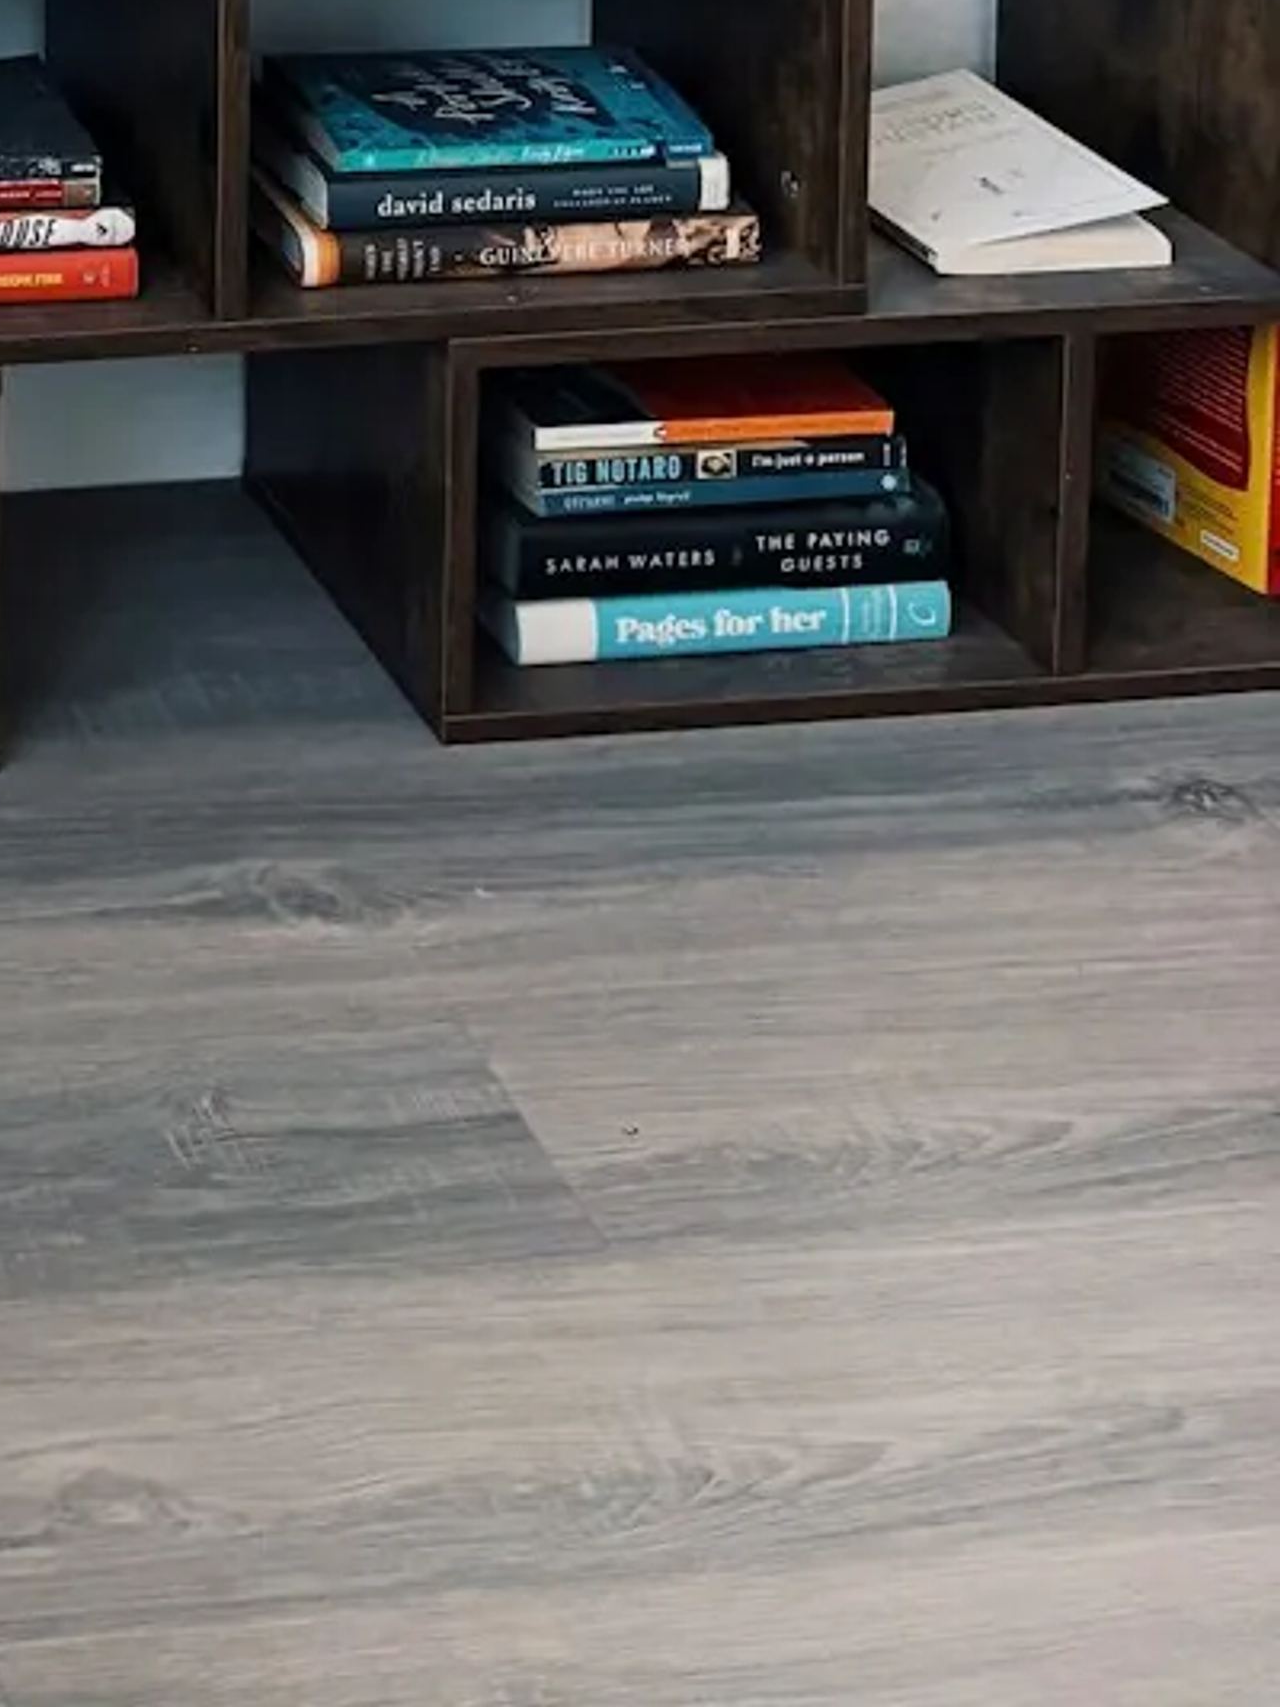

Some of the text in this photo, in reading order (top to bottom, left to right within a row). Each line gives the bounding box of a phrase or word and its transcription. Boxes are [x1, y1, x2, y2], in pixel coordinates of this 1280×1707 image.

[377, 187, 537, 218] david sedaris
[551, 454, 683, 486] TIG NOTARO
[817, 451, 865, 467] person
[755, 529, 891, 551] THE PAYING
[545, 549, 716, 576] SARAH WATERS
[780, 555, 864, 574] GUESTS
[614, 615, 707, 647] Pages
[713, 608, 764, 637] for
[770, 605, 827, 633] her
